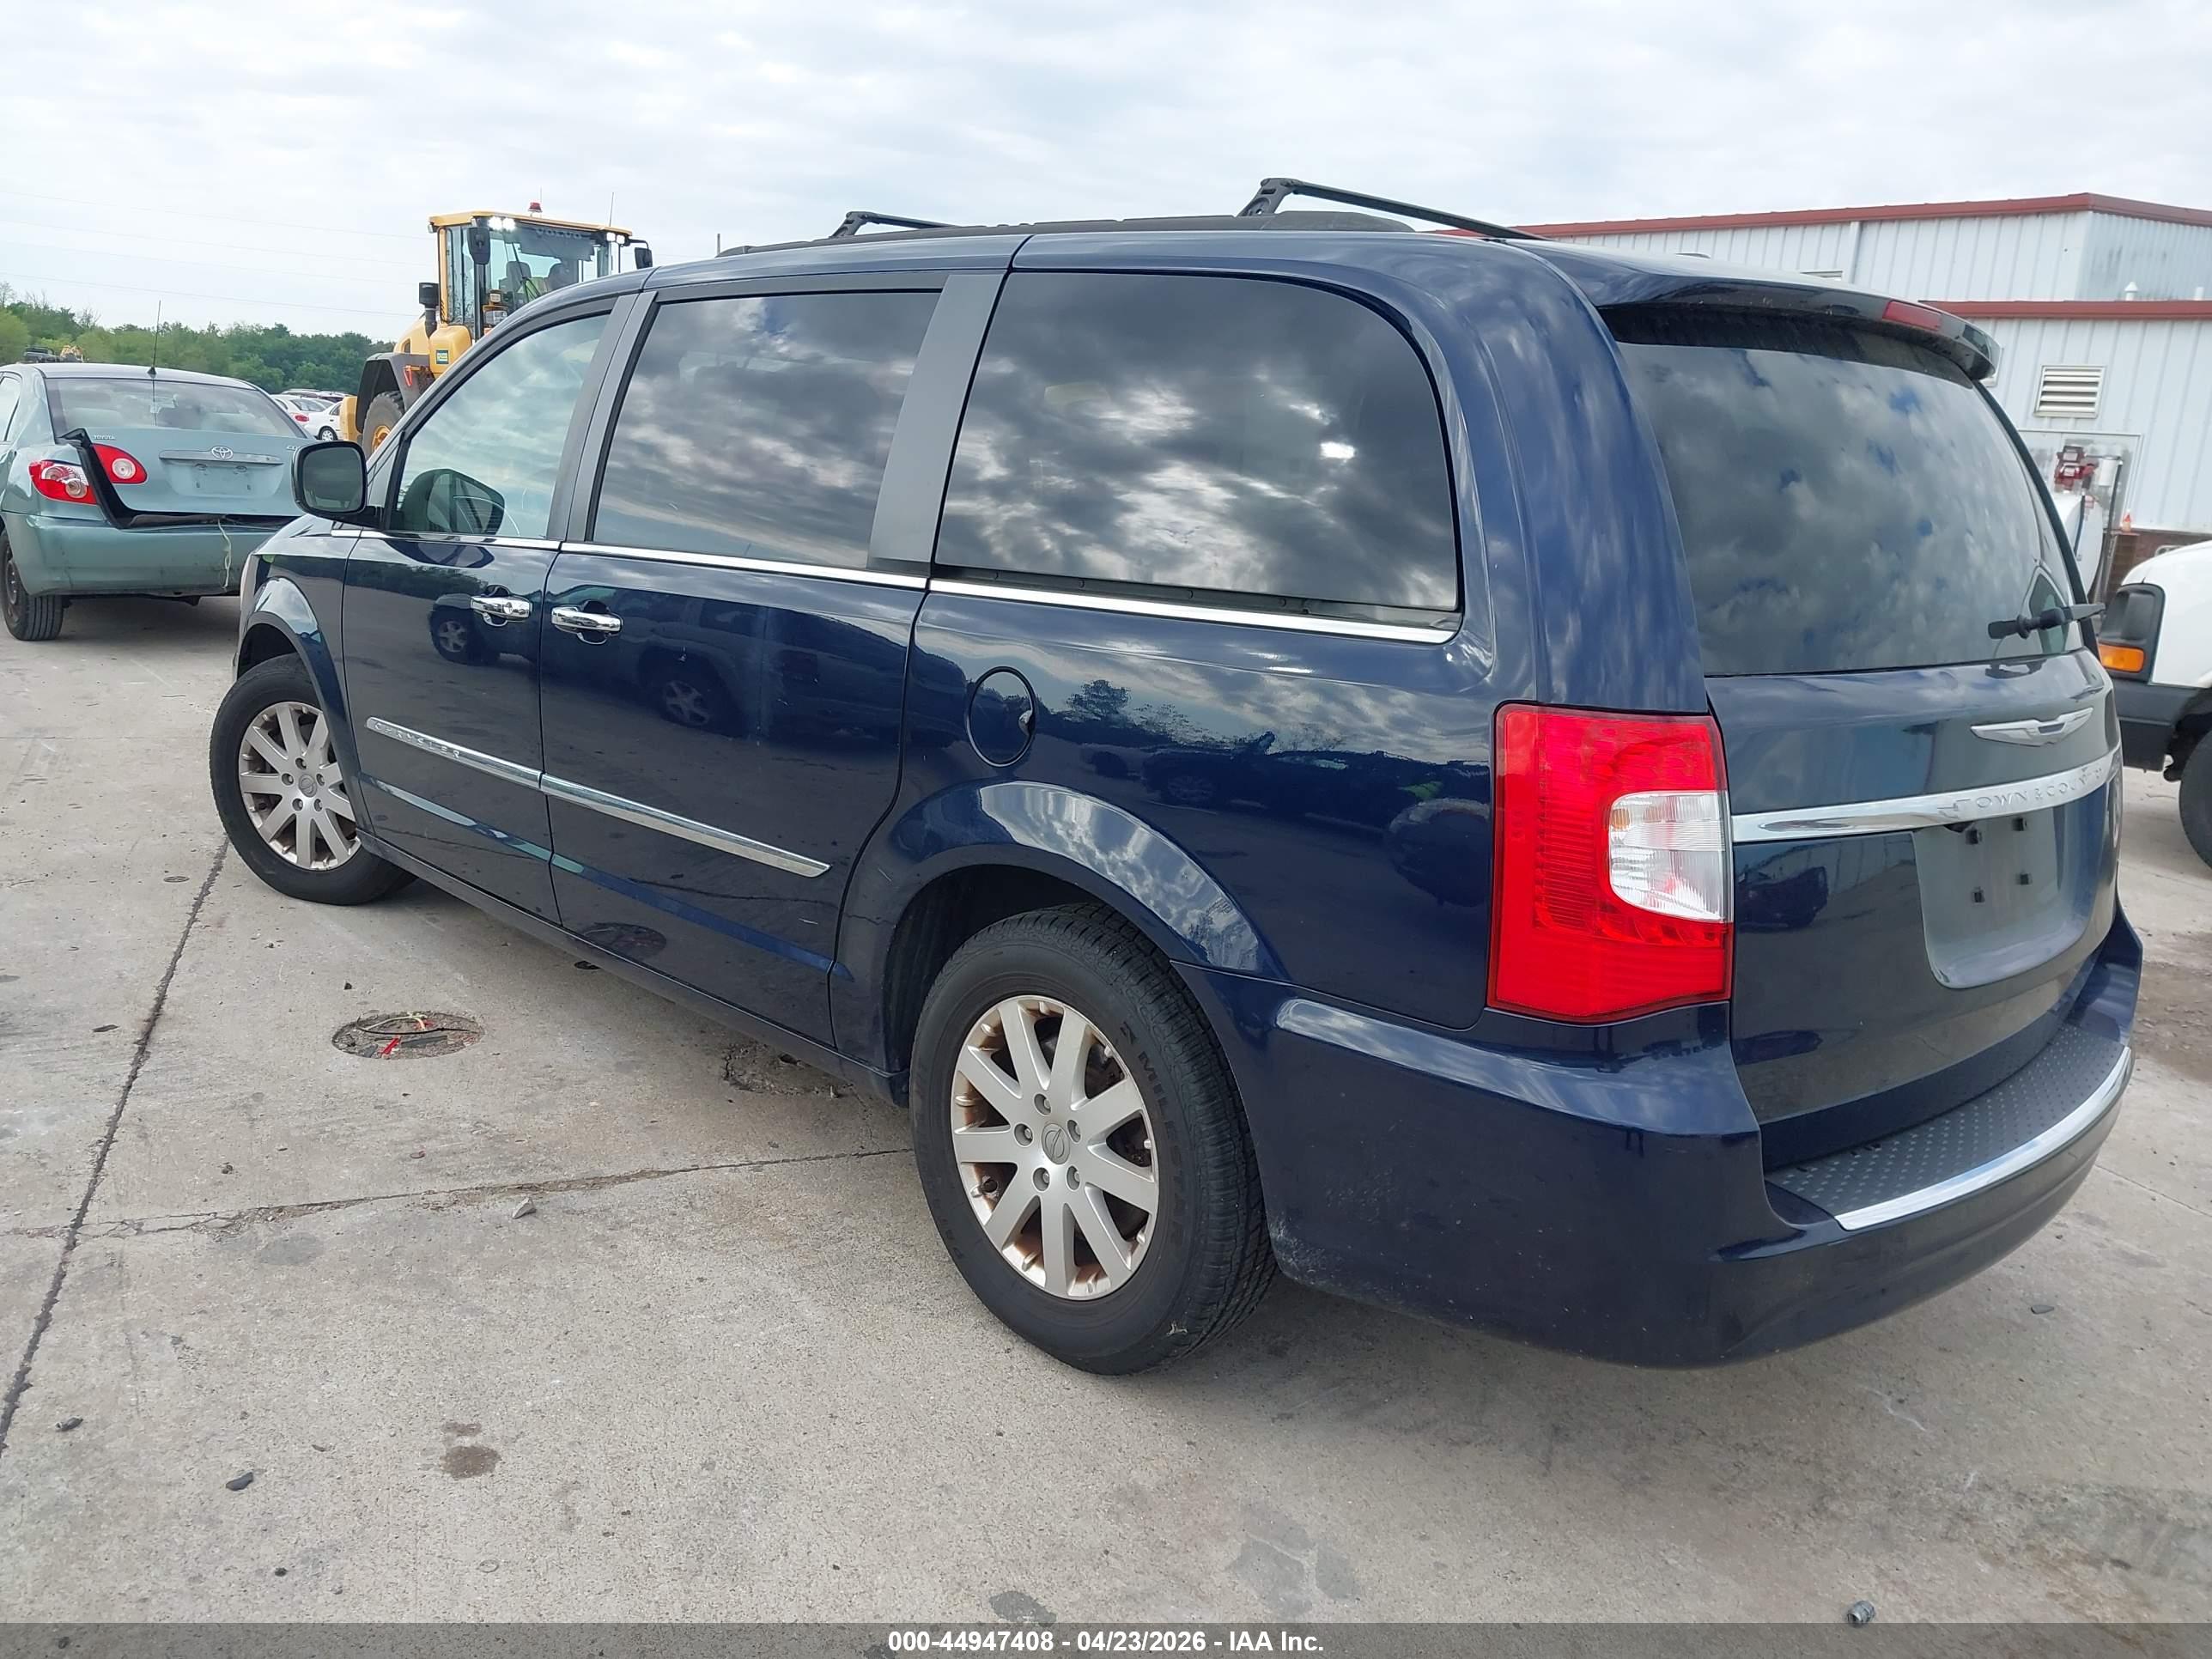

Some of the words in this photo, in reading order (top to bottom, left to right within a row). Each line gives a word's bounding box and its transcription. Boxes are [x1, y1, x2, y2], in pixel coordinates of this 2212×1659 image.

[536, 228, 582, 240] VOLVO
[374, 722, 459, 759] CHRYSLER
[1951, 790, 2027, 812] TOWN
[2034, 787, 2043, 801] &
[2046, 767, 2103, 797] COUNY
